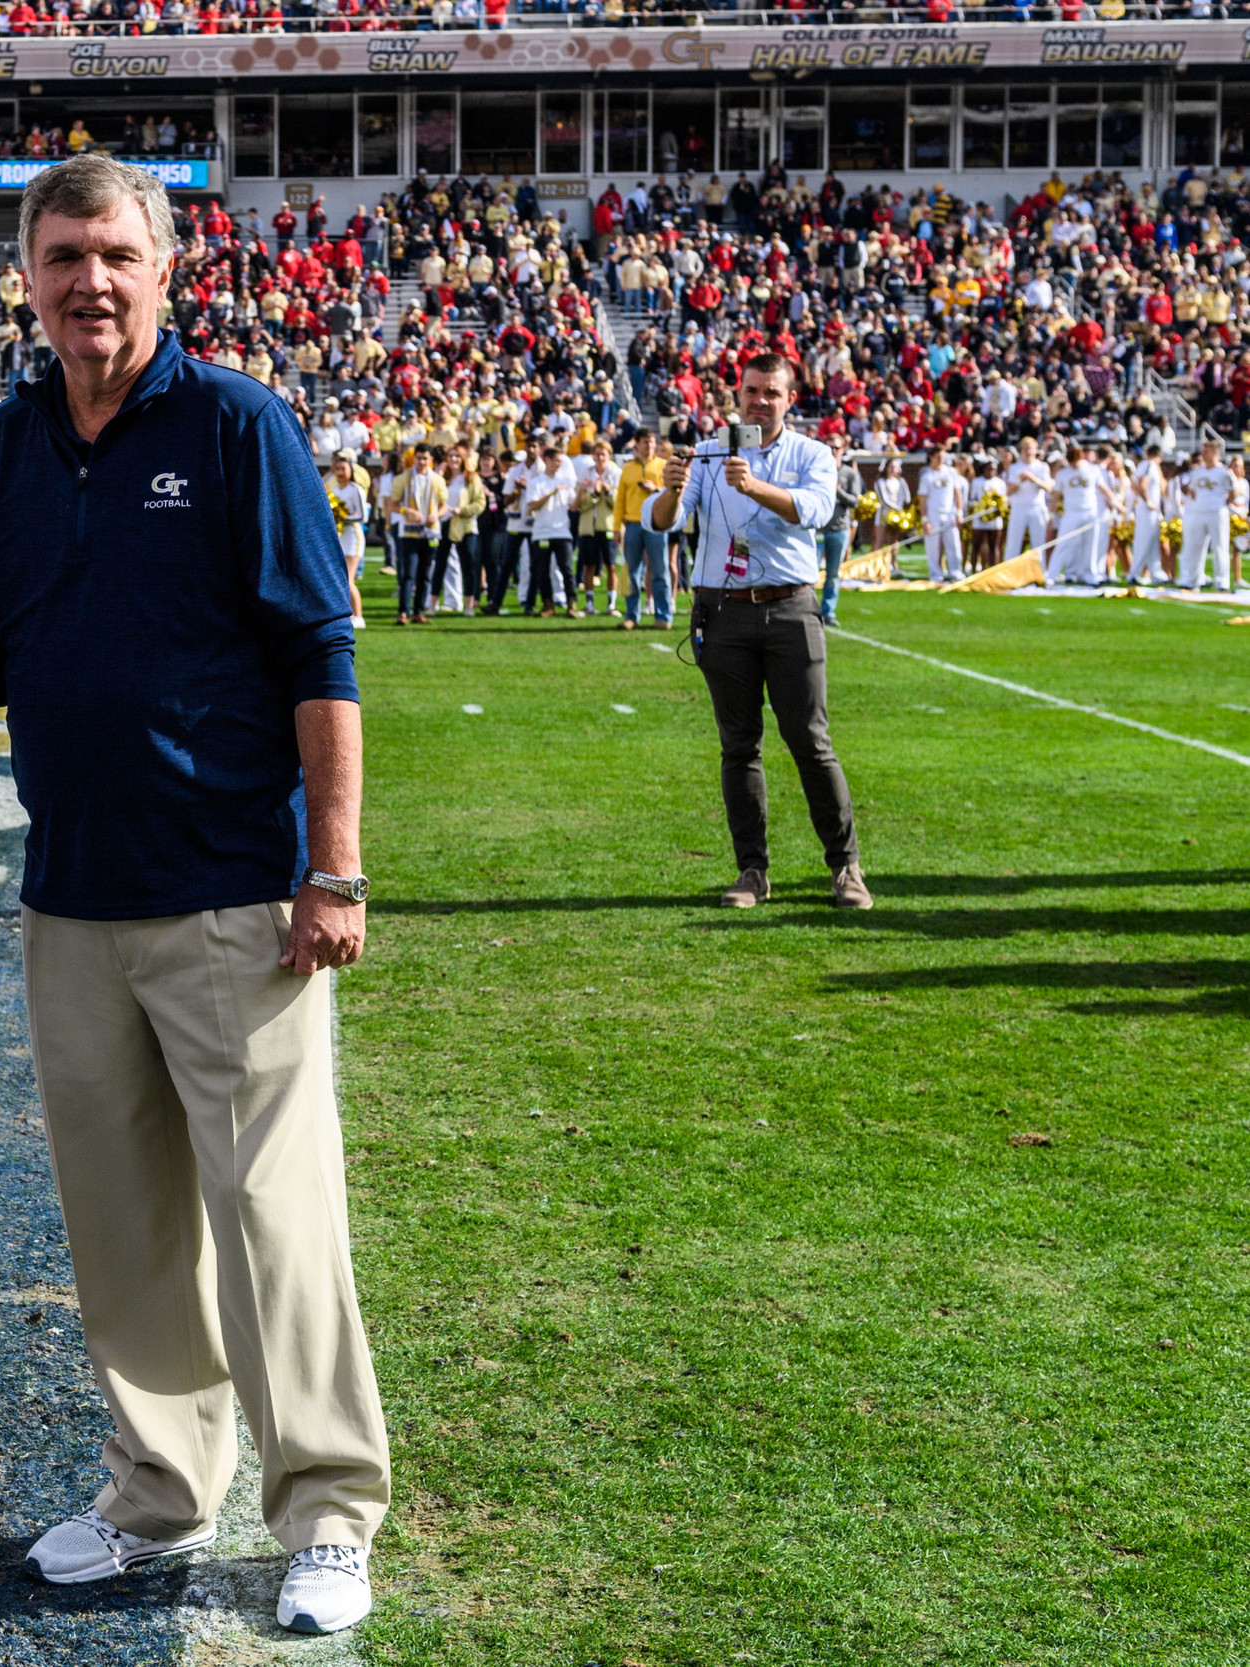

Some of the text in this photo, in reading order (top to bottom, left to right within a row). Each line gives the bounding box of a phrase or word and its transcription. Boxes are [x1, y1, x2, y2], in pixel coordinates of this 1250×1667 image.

[782, 28, 959, 42] COLLEGE FOOTBALL
[1043, 28, 1105, 43] MAXIE
[69, 43, 104, 57] JOE
[368, 38, 419, 52] BILLY
[1042, 41, 1185, 63] BAUGHAN
[368, 50, 458, 71] SHAW
[750, 42, 991, 68] HALL OF FAME
[70, 56, 169, 76] GUYON
[151, 472, 188, 496] GT
[143, 499, 191, 510] FOOTBALL
